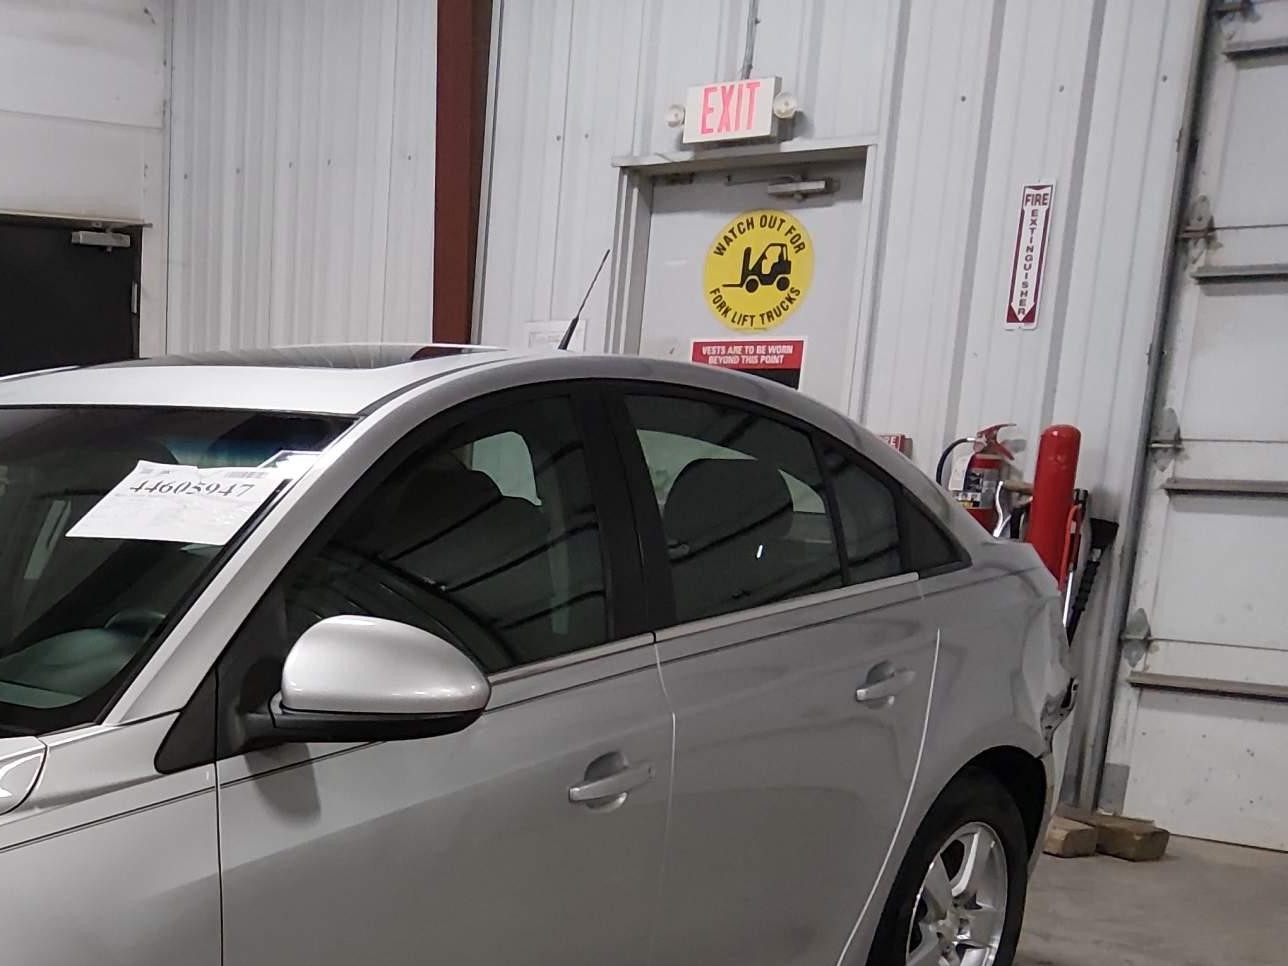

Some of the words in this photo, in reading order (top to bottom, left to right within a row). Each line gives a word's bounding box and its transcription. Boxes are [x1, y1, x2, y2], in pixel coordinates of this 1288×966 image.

[701, 82, 760, 134] EXIT
[1024, 193, 1049, 206] FIRE
[713, 216, 755, 257] WATCH
[759, 214, 786, 231] OUT
[784, 226, 806, 254] FOR
[1017, 209, 1039, 315] EXTINGUISHER
[709, 287, 732, 319] FORK
[731, 312, 755, 327] LIFT
[759, 286, 801, 326] TRUCKS
[702, 345, 726, 355] VESTS
[727, 345, 743, 355] ARE
[744, 345, 755, 354] TO
[756, 345, 767, 354] BE
[768, 345, 793, 354] WORN
[708, 355, 740, 365] BEYOND
[741, 355, 759, 365] THIS
[759, 354, 785, 364] POINT
[130, 480, 256, 497] 44605947
